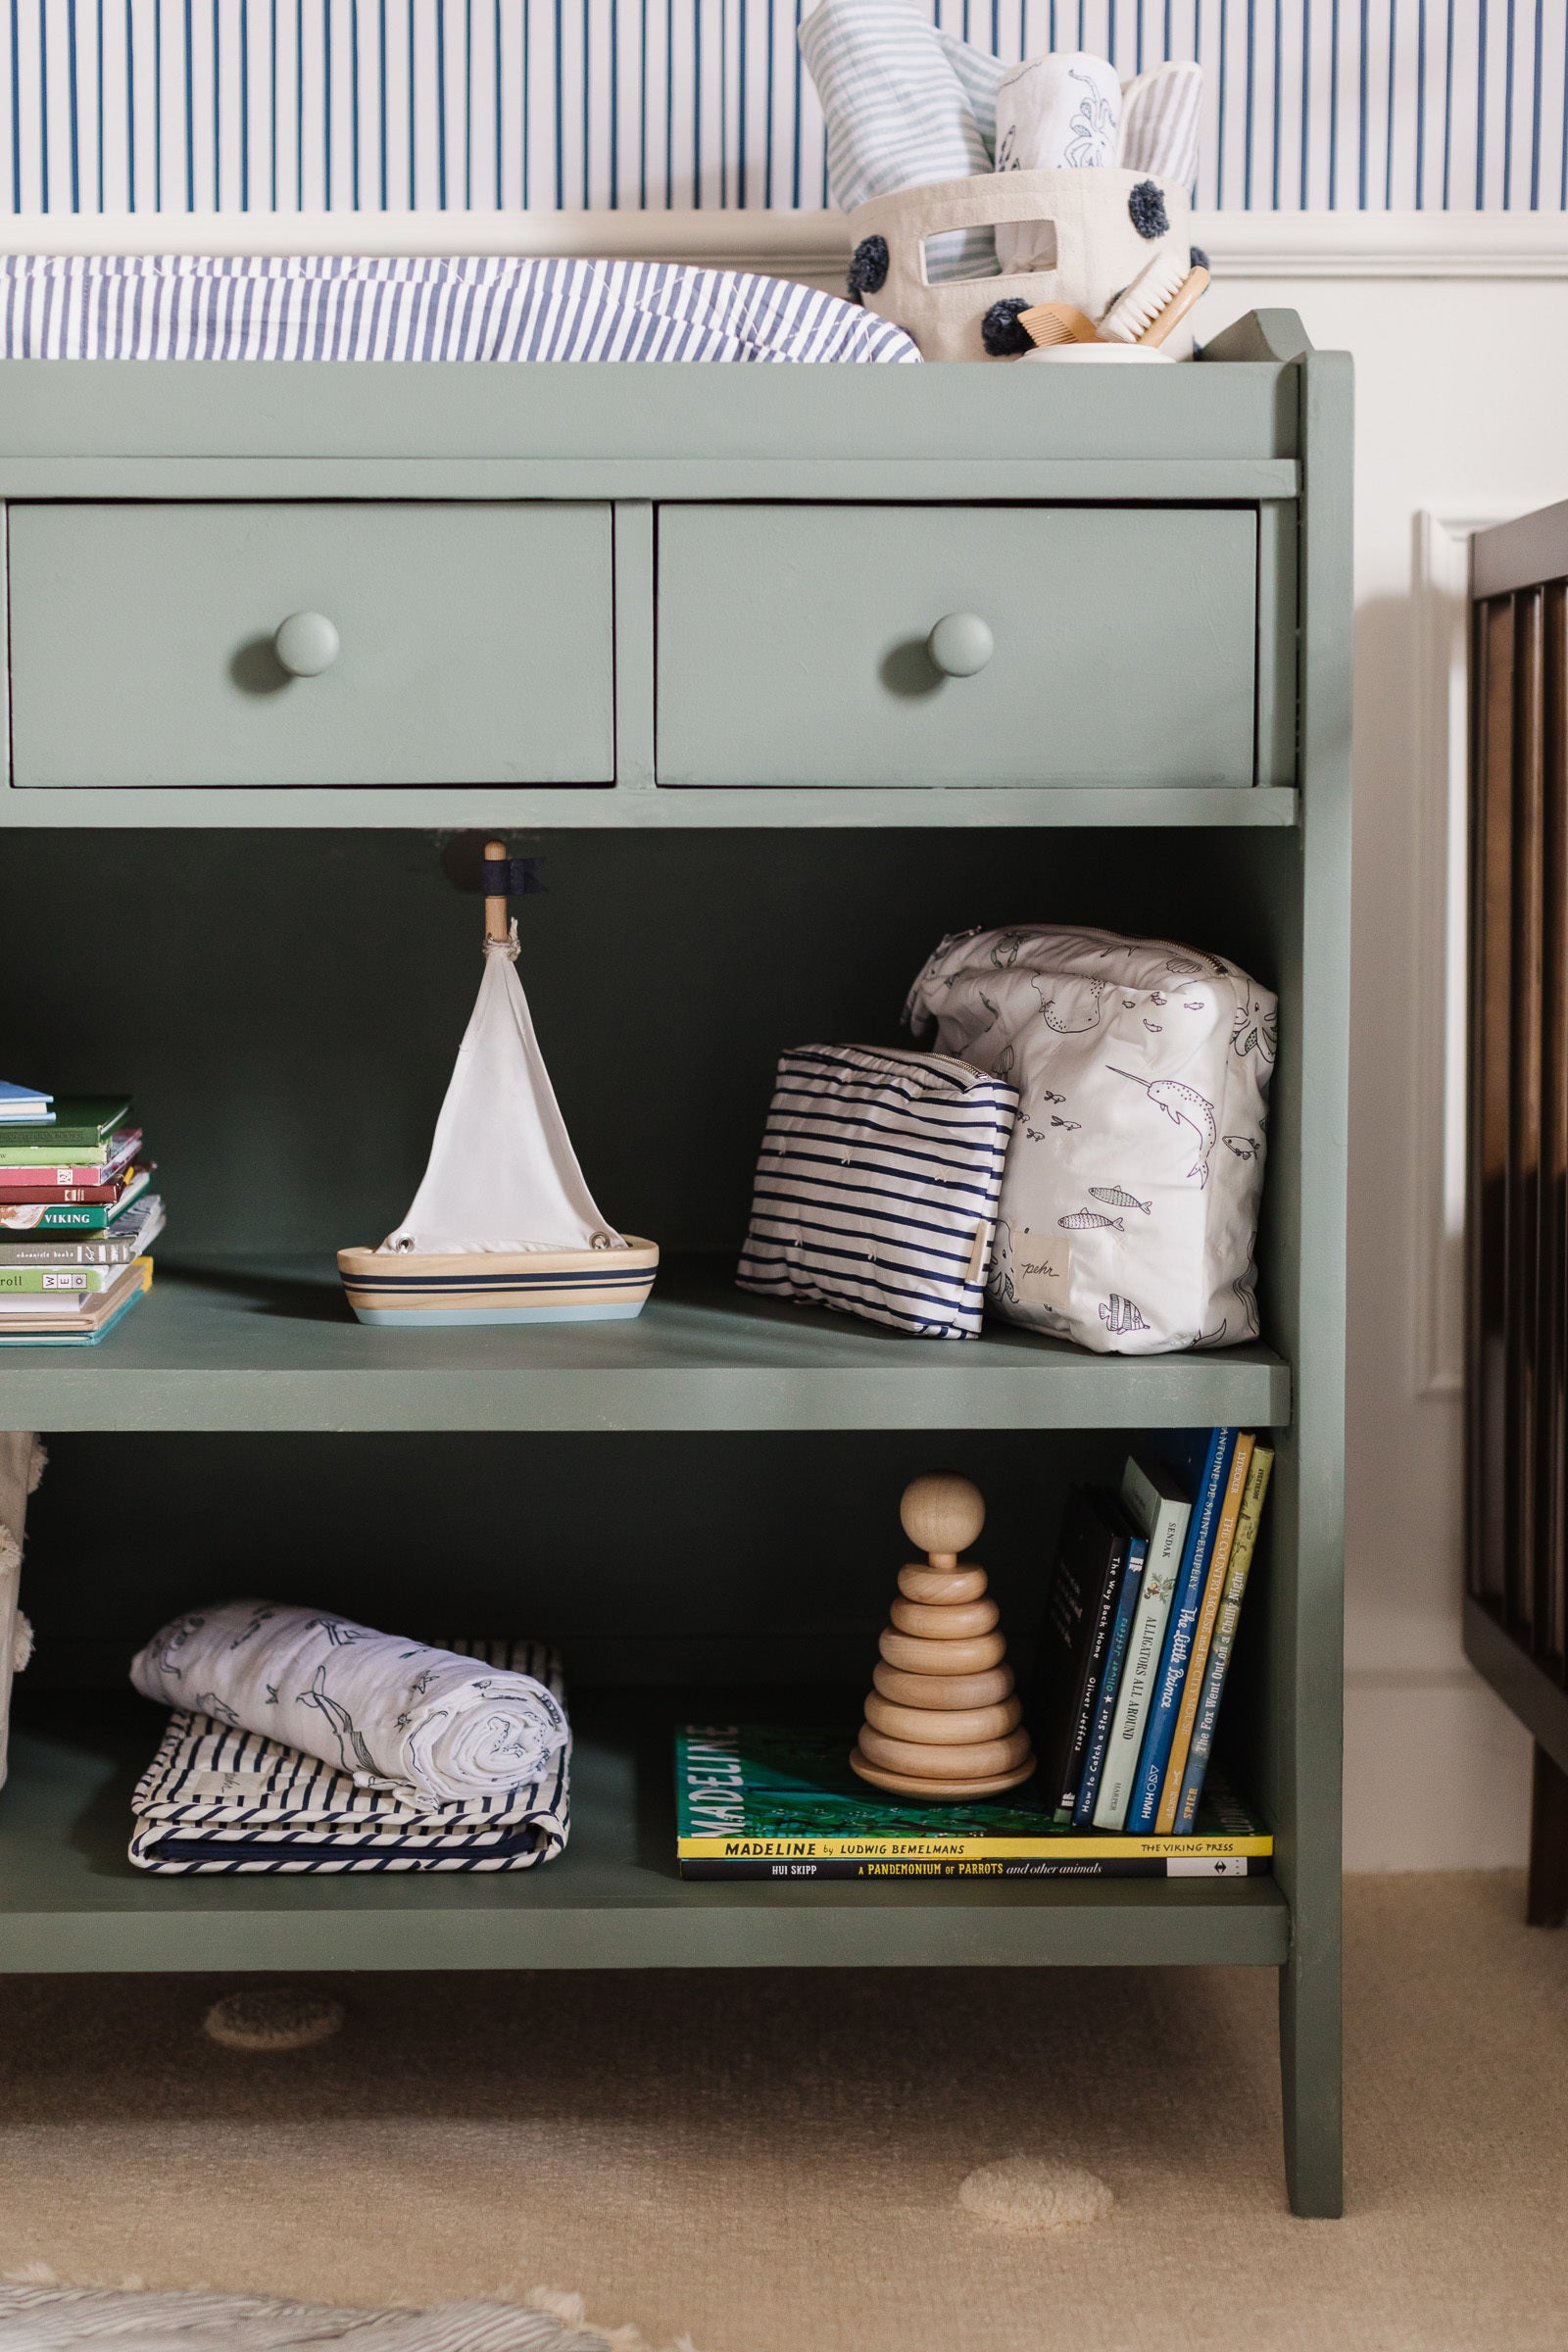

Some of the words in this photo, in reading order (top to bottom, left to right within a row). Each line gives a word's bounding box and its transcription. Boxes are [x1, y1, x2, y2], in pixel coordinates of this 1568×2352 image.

[45, 1214, 90, 1224] VIKING
[0, 1276, 23, 1286] roll
[1021, 1260, 1059, 1279] pehr
[1231, 1451, 1247, 1494] LYDECKER
[1207, 1483, 1218, 1497] DE
[1162, 1522, 1176, 1558] SENDAK
[1220, 1517, 1234, 1540] THE
[1110, 1557, 1121, 1576] The
[1210, 1540, 1230, 1593] COUNTRY
[1102, 1580, 1116, 1600] Way
[1228, 1571, 1245, 1600] Night
[1099, 1604, 1110, 1628] Back
[1178, 1607, 1198, 1629] The
[1201, 1594, 1218, 1634] MOUSE
[1221, 1602, 1240, 1634] Chilly
[1093, 1632, 1105, 1659] Home
[1106, 1660, 1119, 1692] Oliver
[1113, 1617, 1128, 1656] Jeffers
[1136, 1616, 1157, 1676] ALLIGATORS
[1171, 1629, 1191, 1663] Little
[1218, 1645, 1229, 1660] on
[1211, 1661, 1225, 1680] Out
[1084, 1677, 1097, 1708] Oliver
[1130, 1678, 1144, 1698] ALL
[1160, 1667, 1184, 1708] Prince
[1205, 1683, 1221, 1709] Went
[1074, 1712, 1089, 1751] Jeffers
[1098, 1709, 1109, 1731] Star
[1122, 1700, 1140, 1740] AROUND
[1200, 1710, 1214, 1731] Fox
[1195, 1732, 1209, 1753] The
[1089, 1744, 1102, 1773] Catch
[687, 1726, 746, 1838] MADELINE
[1086, 1777, 1095, 1787] to
[1081, 1791, 1092, 1812] How
[1141, 1792, 1154, 1819] HMH
[1183, 1787, 1199, 1820] SPIER
[725, 1843, 816, 1855] MADELINE
[823, 1844, 833, 1855] by
[840, 1844, 887, 1854] LUDWIG
[892, 1844, 965, 1854] BEMELMANS
[1141, 1843, 1160, 1852] THE
[1163, 1843, 1202, 1852] VIKING
[771, 1865, 788, 1875] HUI
[791, 1865, 817, 1875] SKIPP
[858, 1866, 864, 1875] A
[868, 1864, 941, 1875] PANDEMONIUM
[958, 1863, 1004, 1875] PARROTS
[1005, 1863, 1029, 1874] and
[1029, 1863, 1058, 1874] other
[1058, 1863, 1102, 1874] animals
